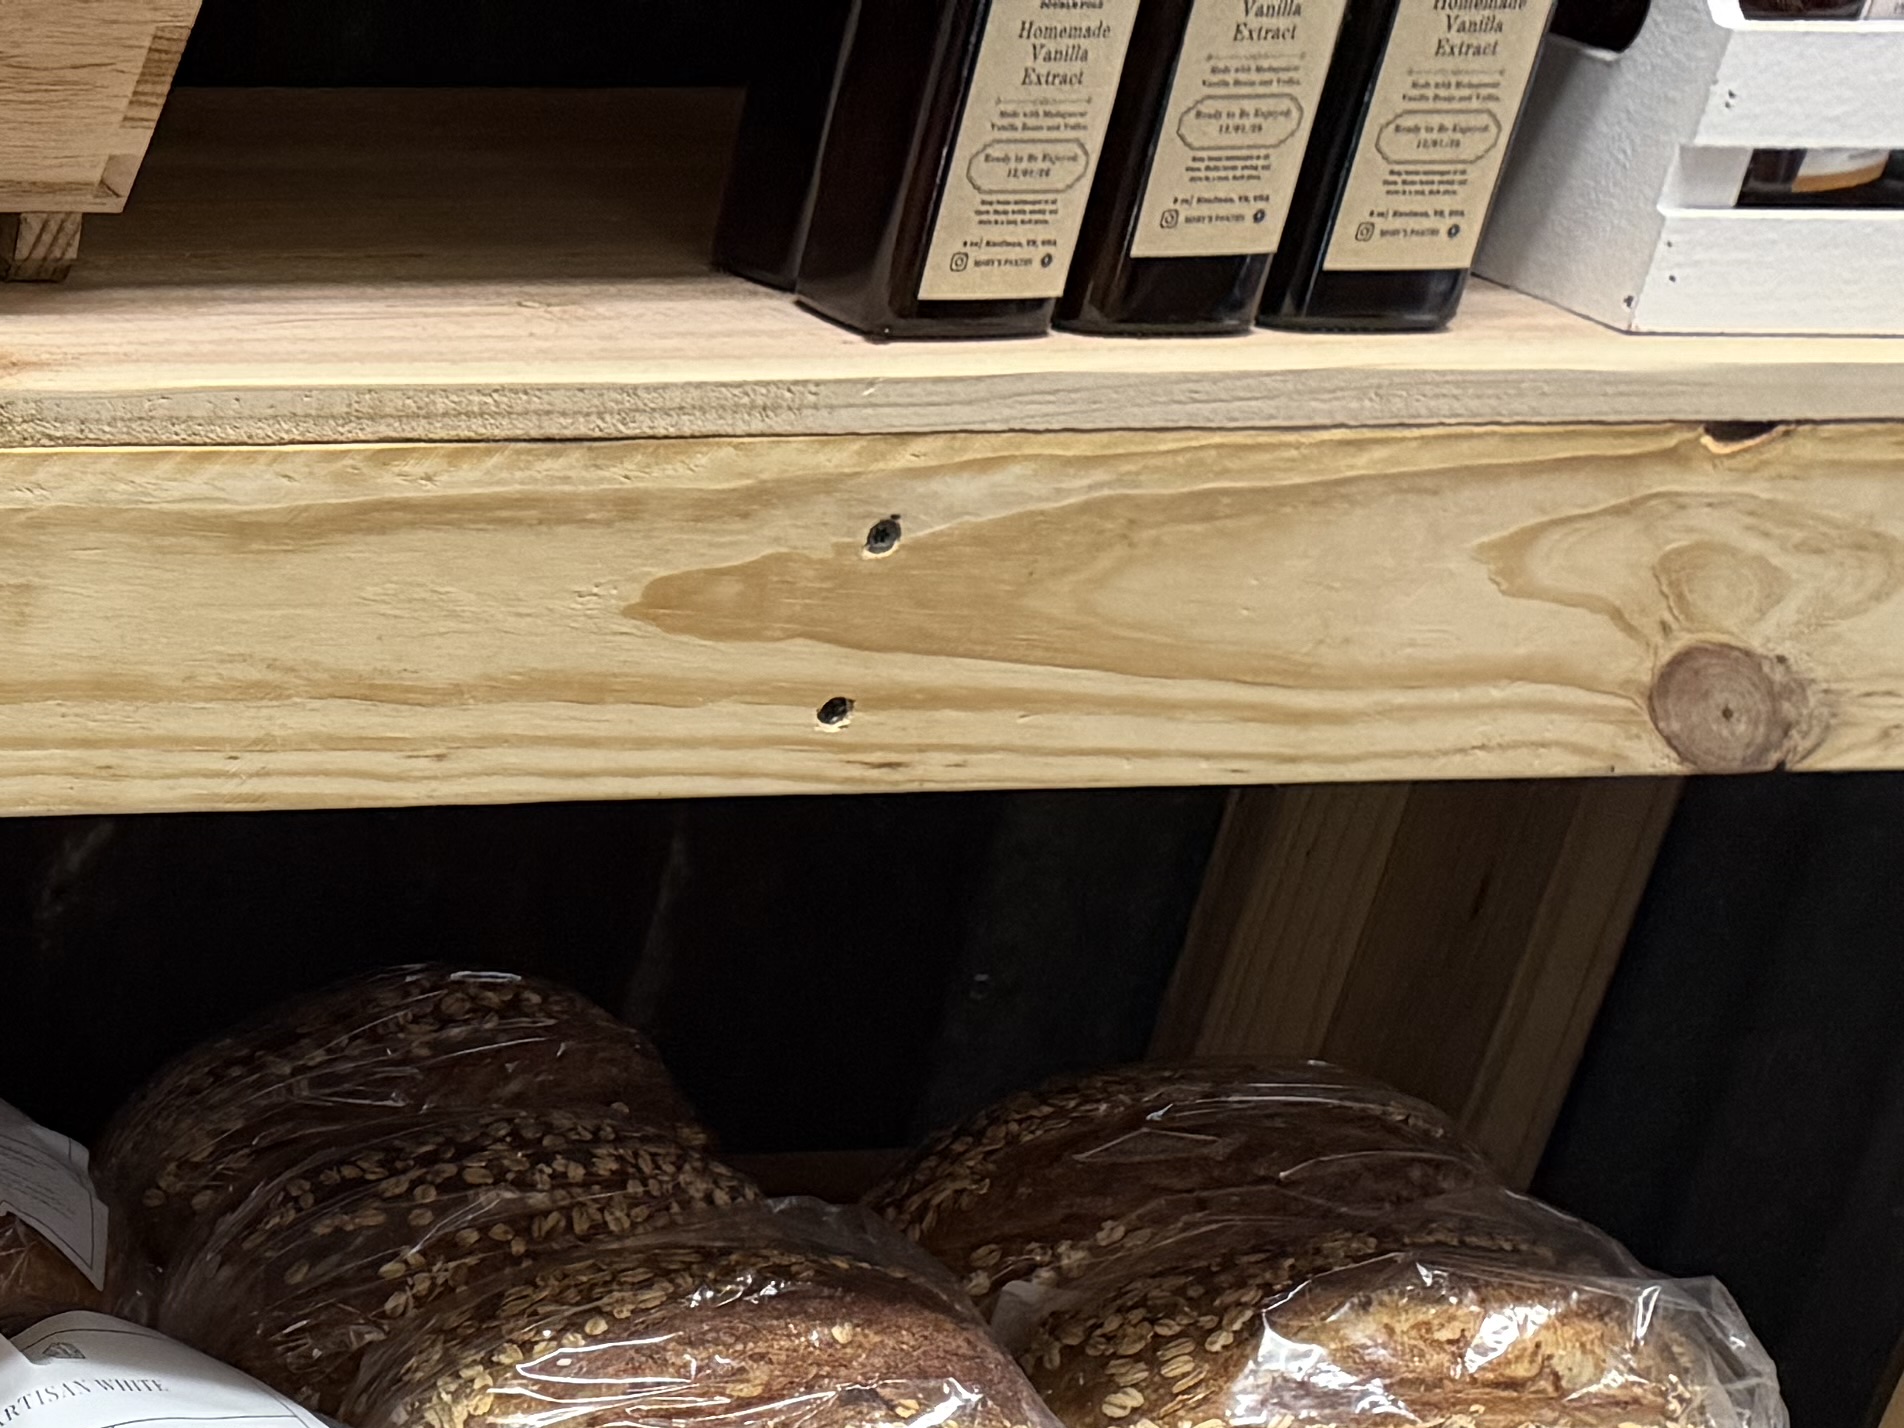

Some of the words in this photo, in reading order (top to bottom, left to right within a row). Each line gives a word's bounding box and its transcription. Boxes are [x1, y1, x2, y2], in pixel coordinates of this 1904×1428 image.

[1018, 20, 1111, 40] Homemade
[1030, 43, 1089, 64] Vanilla
[1021, 66, 1084, 87] Extract
[92, 1376, 170, 1395] WHITE
